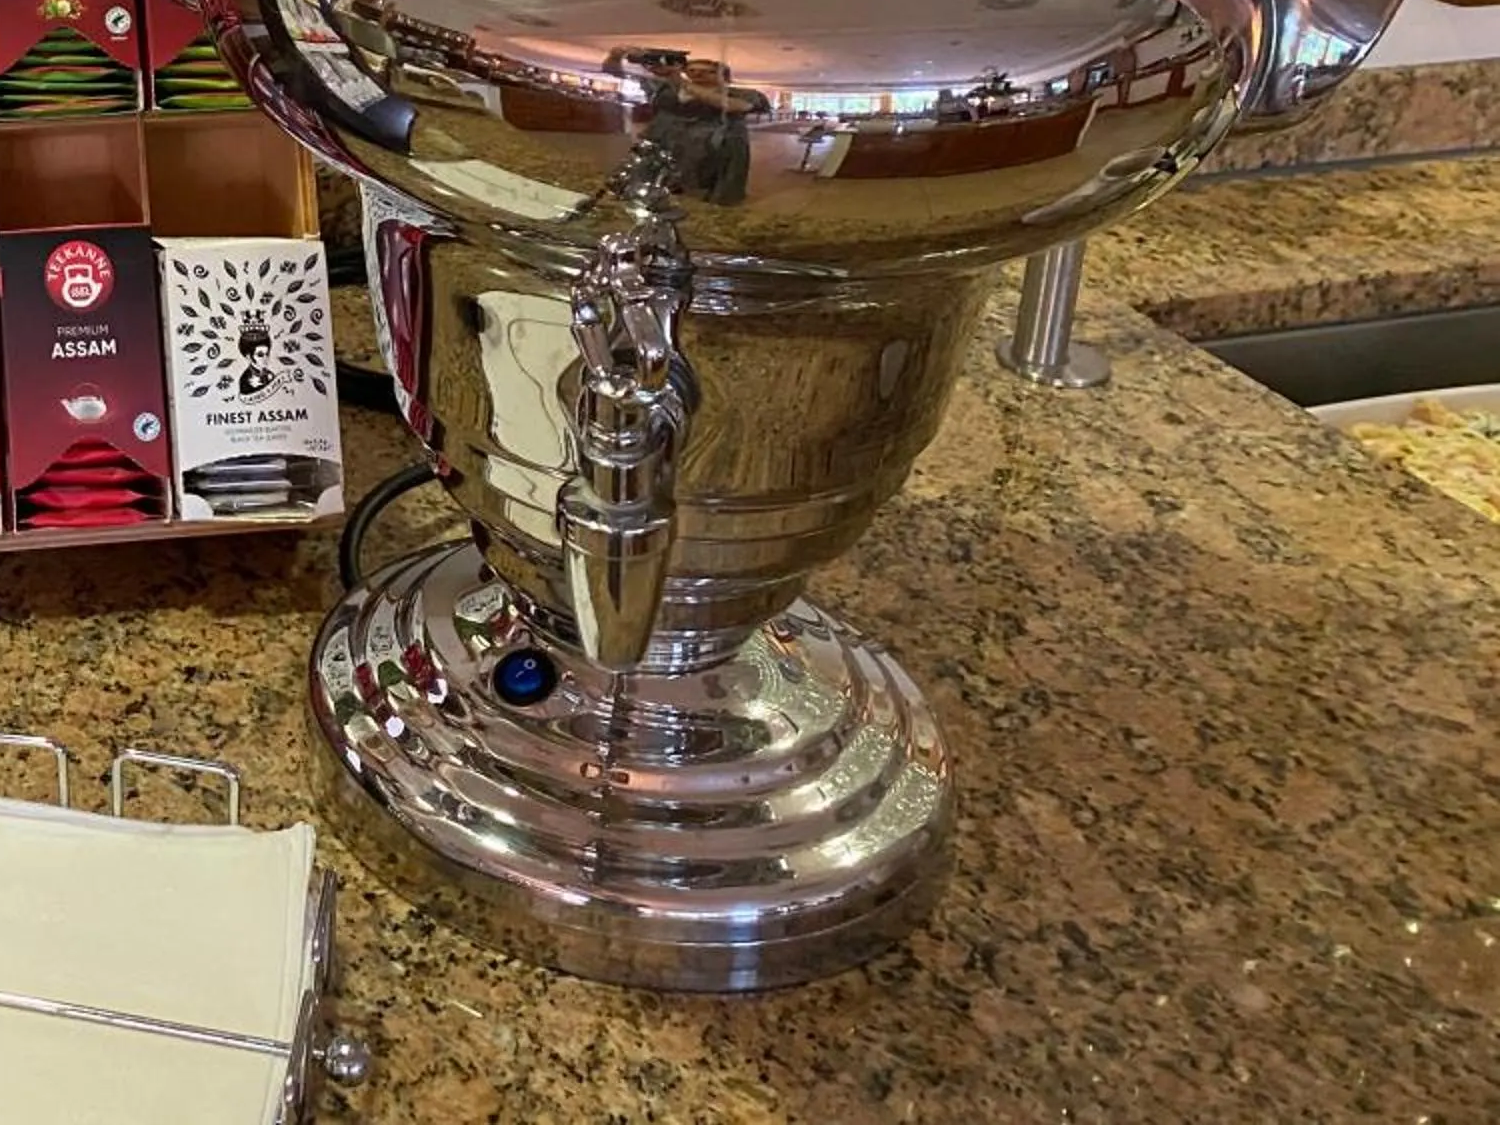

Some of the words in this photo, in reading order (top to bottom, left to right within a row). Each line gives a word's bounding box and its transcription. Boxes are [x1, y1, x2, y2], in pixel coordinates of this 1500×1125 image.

[48, 245, 112, 282] TEEKANNE
[57, 324, 109, 336] PREMIUM
[51, 339, 118, 360] ASSAM
[206, 410, 252, 426] FINEST
[257, 408, 309, 423] ASSAM
